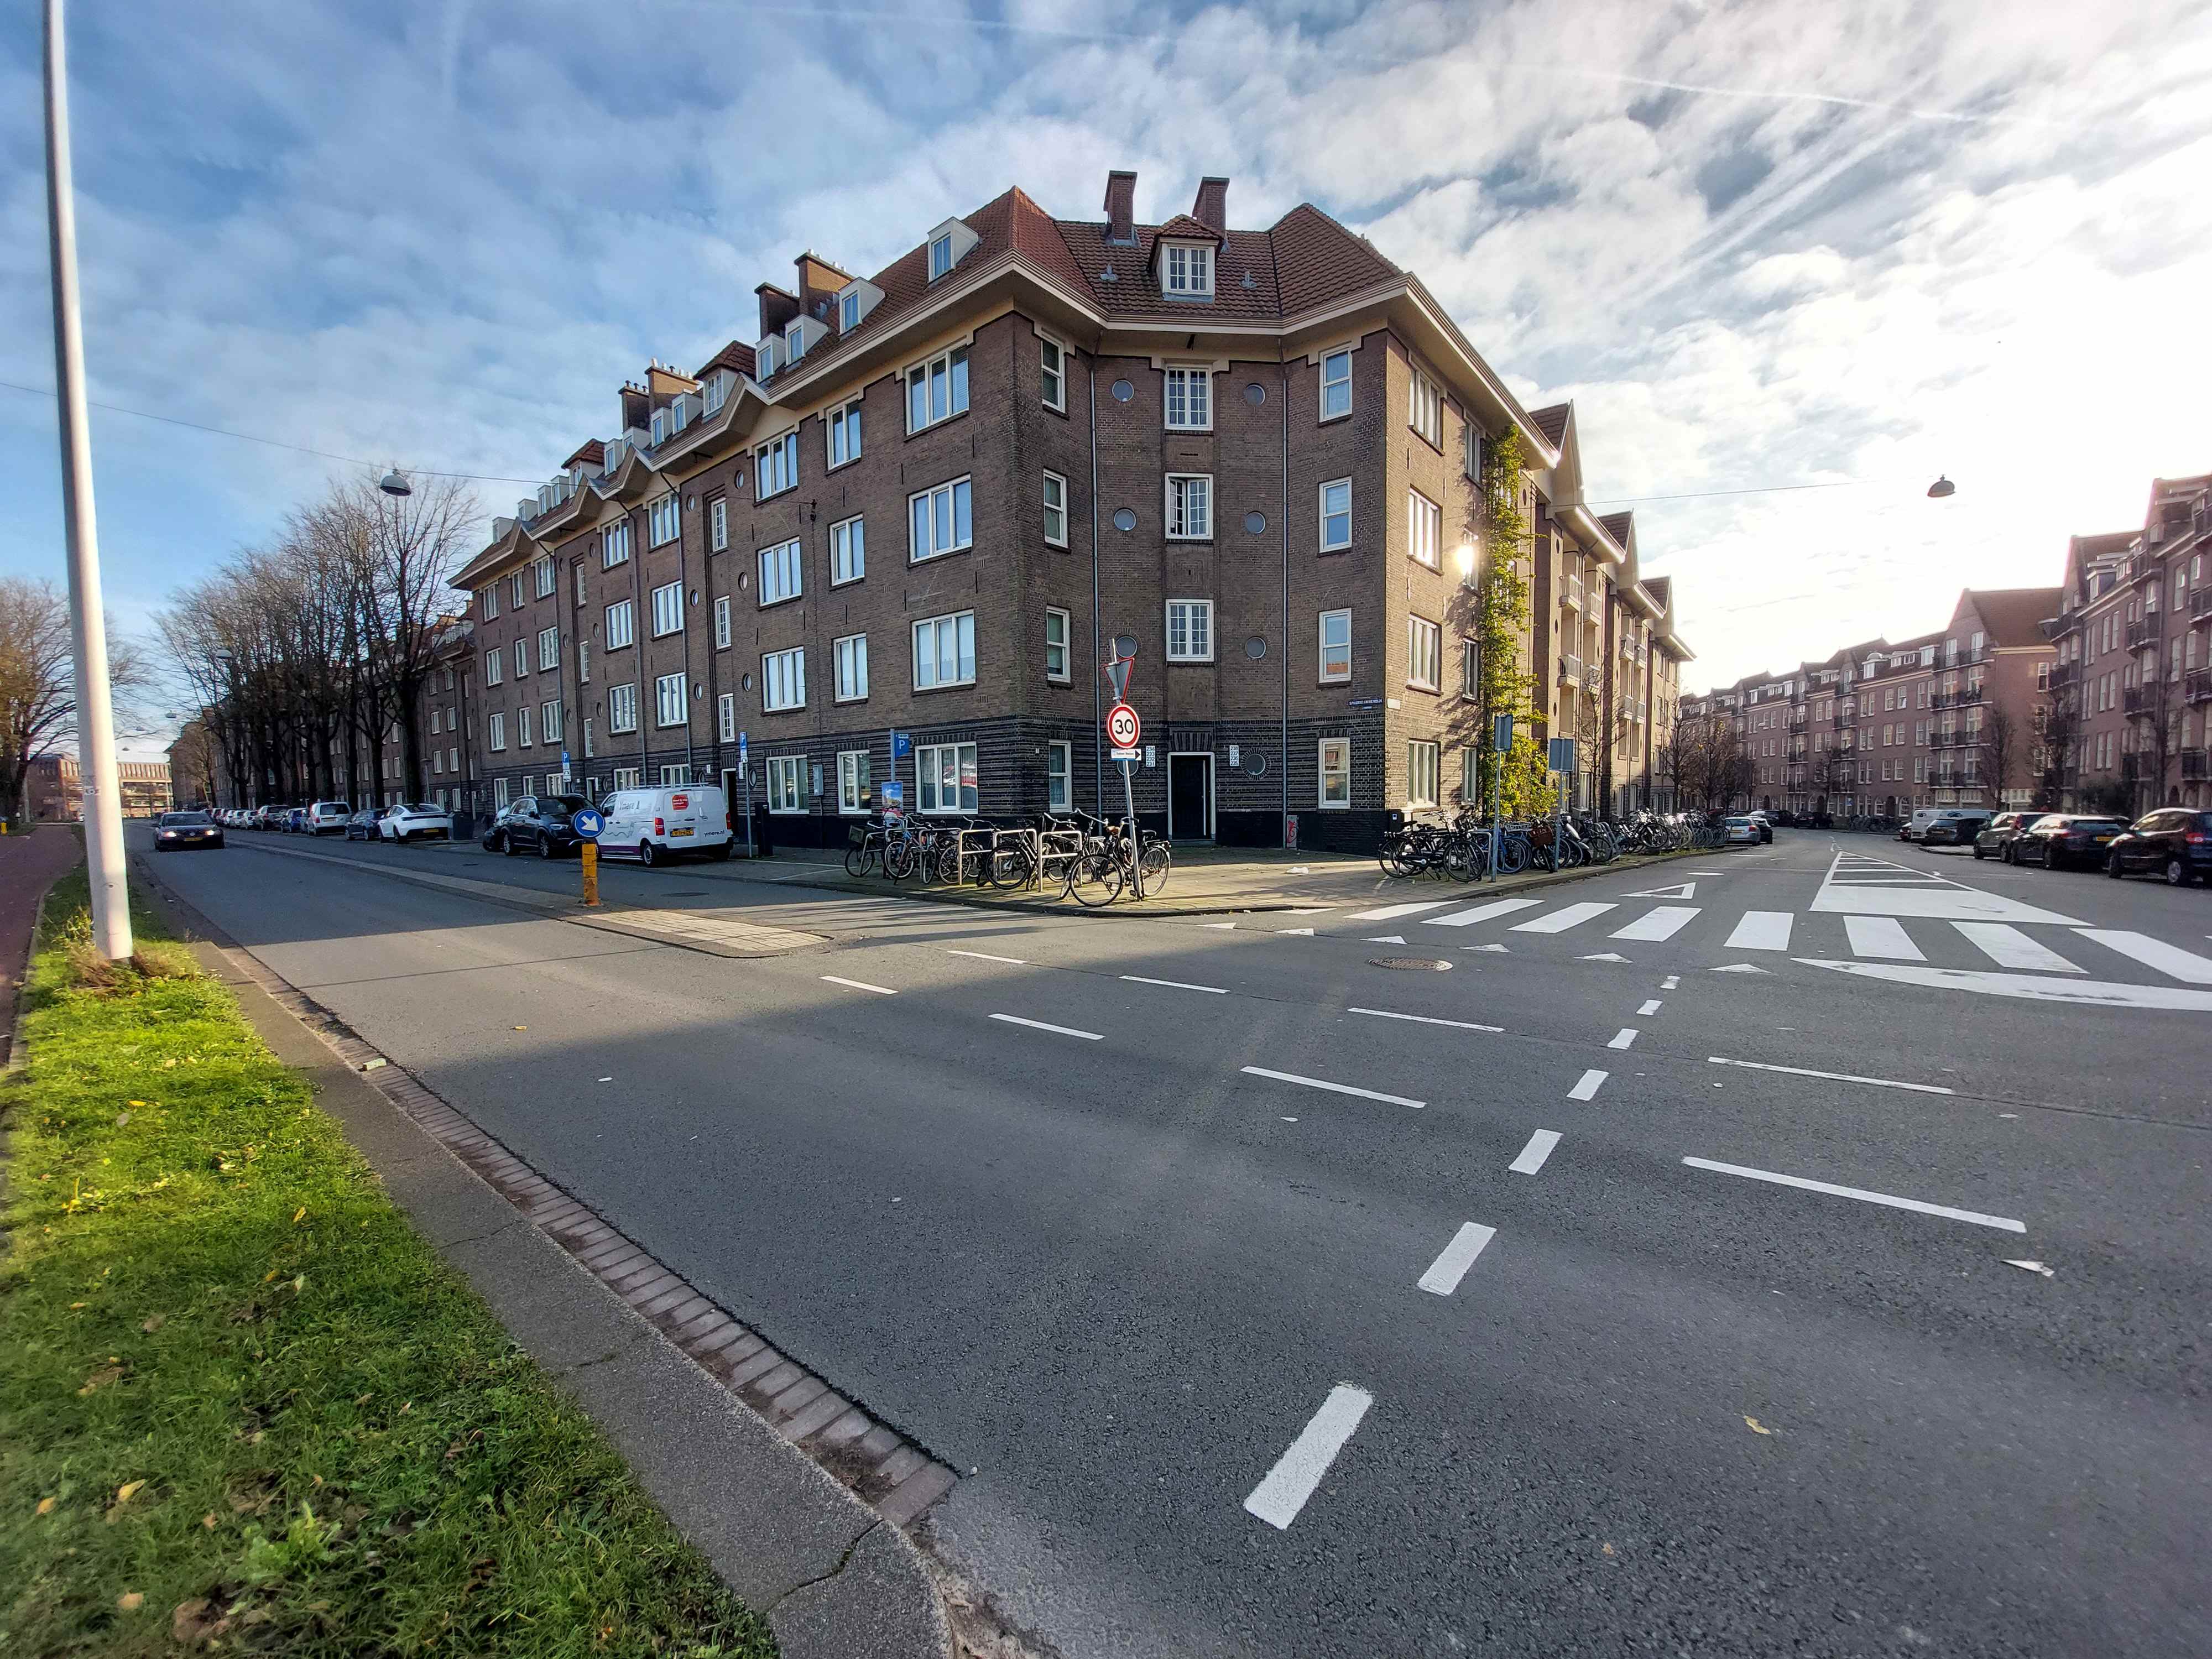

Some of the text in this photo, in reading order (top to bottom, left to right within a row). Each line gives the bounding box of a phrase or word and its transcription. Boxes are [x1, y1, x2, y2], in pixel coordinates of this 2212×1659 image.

[1115, 719, 1134, 734] 30
[742, 734, 745, 743] P
[899, 740, 905, 749] P
[564, 753, 567, 761] P
